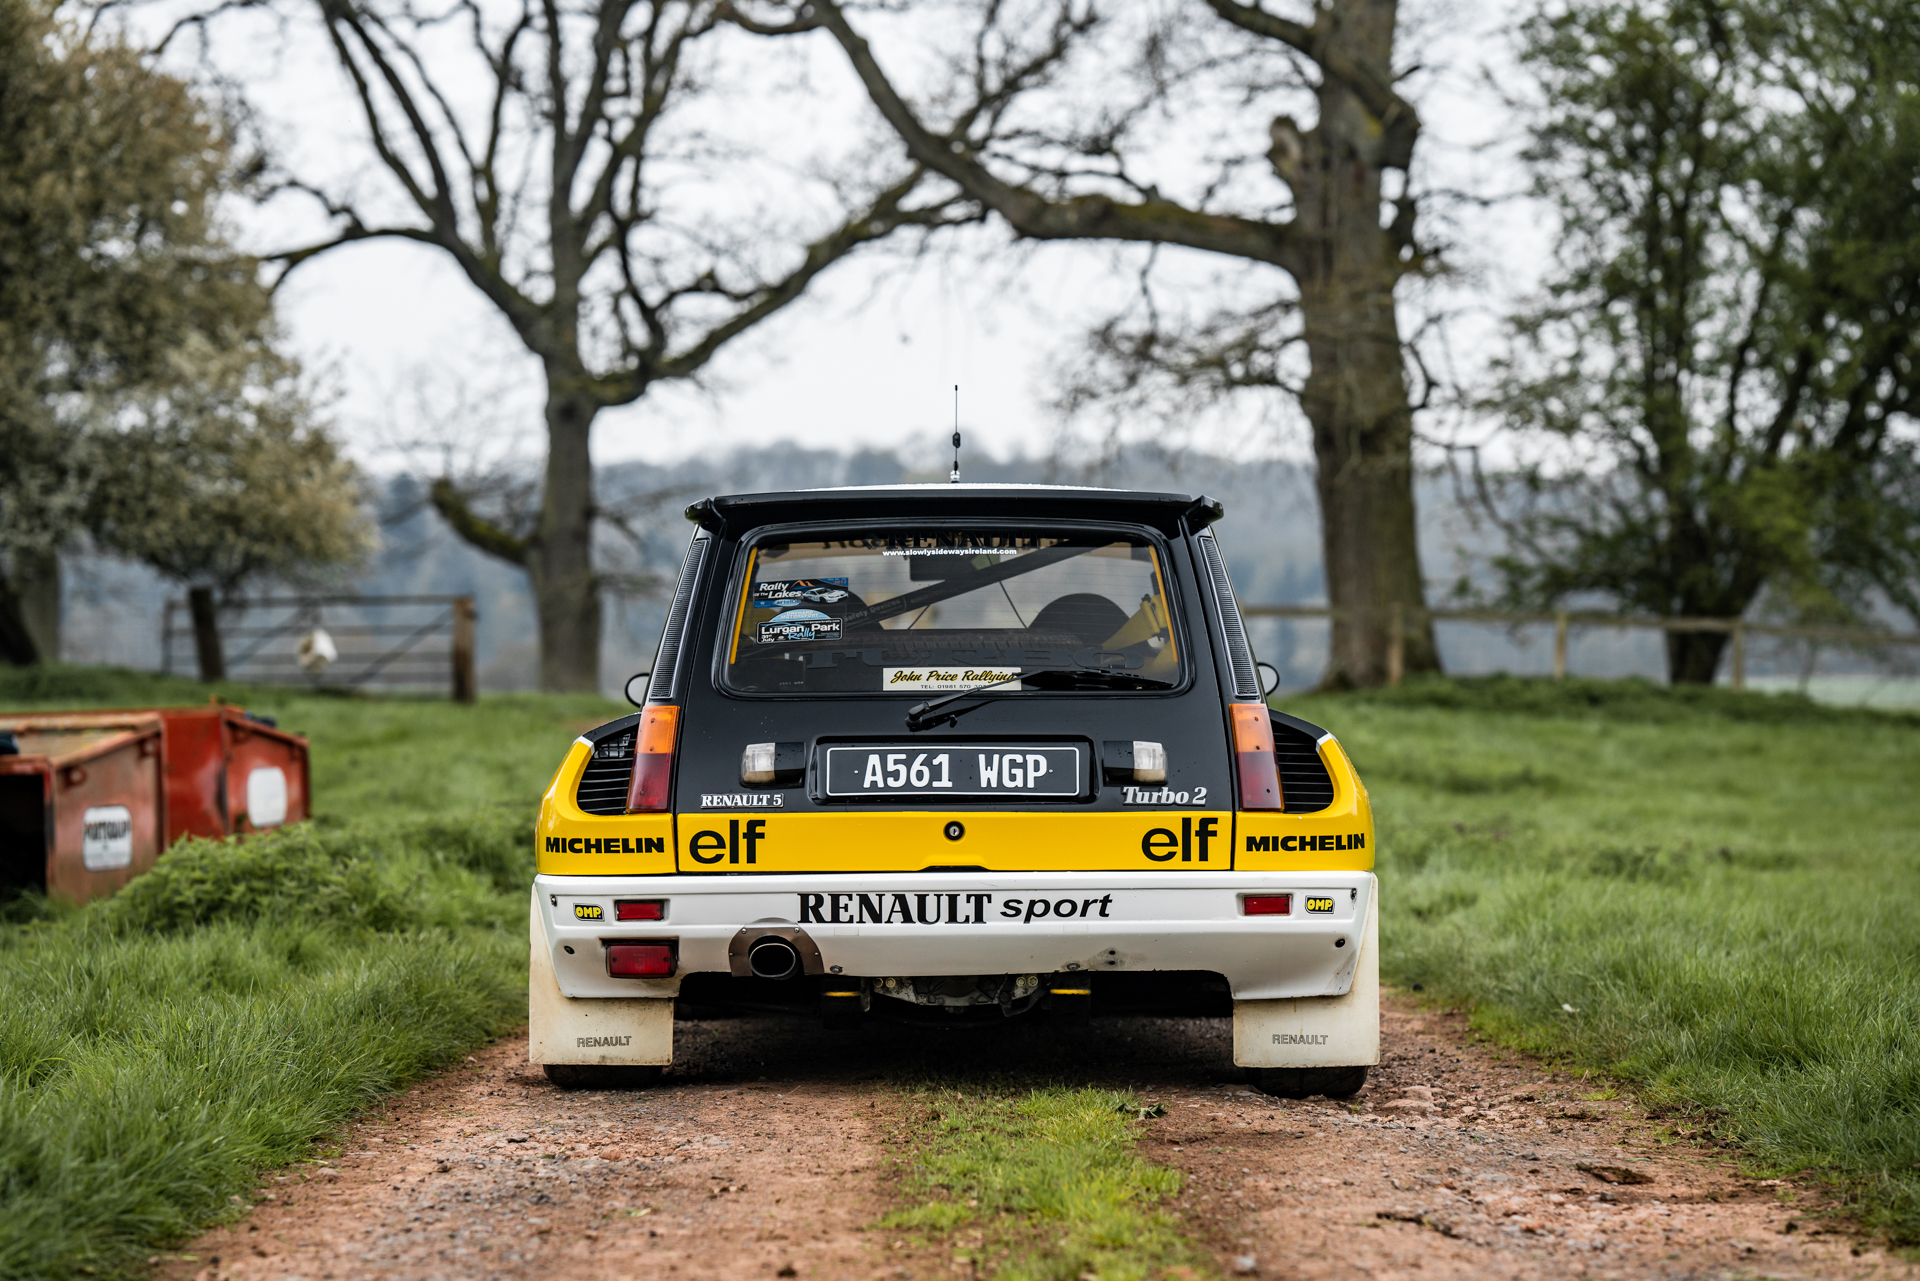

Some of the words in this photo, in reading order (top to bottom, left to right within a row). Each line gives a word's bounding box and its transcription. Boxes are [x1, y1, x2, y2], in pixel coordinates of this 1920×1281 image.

[886, 531, 1045, 549] RENAULT
[882, 548, 1017, 557] www.slowlysidewaysireland.com
[759, 582, 789, 591] Rally
[768, 590, 802, 598] Lakes
[869, 599, 901, 613] Devices
[761, 625, 804, 635] Lurgan
[812, 623, 840, 631] Park
[788, 628, 816, 640] Rally
[890, 670, 923, 684] John
[926, 670, 959, 682] Price
[962, 670, 1016, 684] Rallying
[863, 753, 953, 788] A561
[978, 753, 1048, 788] WGP
[701, 794, 771, 807] RENAULT
[773, 794, 783, 806] 5
[1123, 786, 1190, 805] Turbo
[1193, 786, 1208, 805] 2
[546, 836, 665, 854] MICHELIN
[689, 819, 766, 864] elf
[1141, 817, 1219, 862] elf
[1246, 833, 1365, 852] MICHELIN
[797, 893, 992, 925] RENAULT
[1000, 893, 1113, 924] sport
[1307, 899, 1333, 911] OMP
[575, 906, 602, 918] OMP
[576, 1036, 632, 1048] RENAULT
[1272, 1034, 1328, 1045] RENAULT
